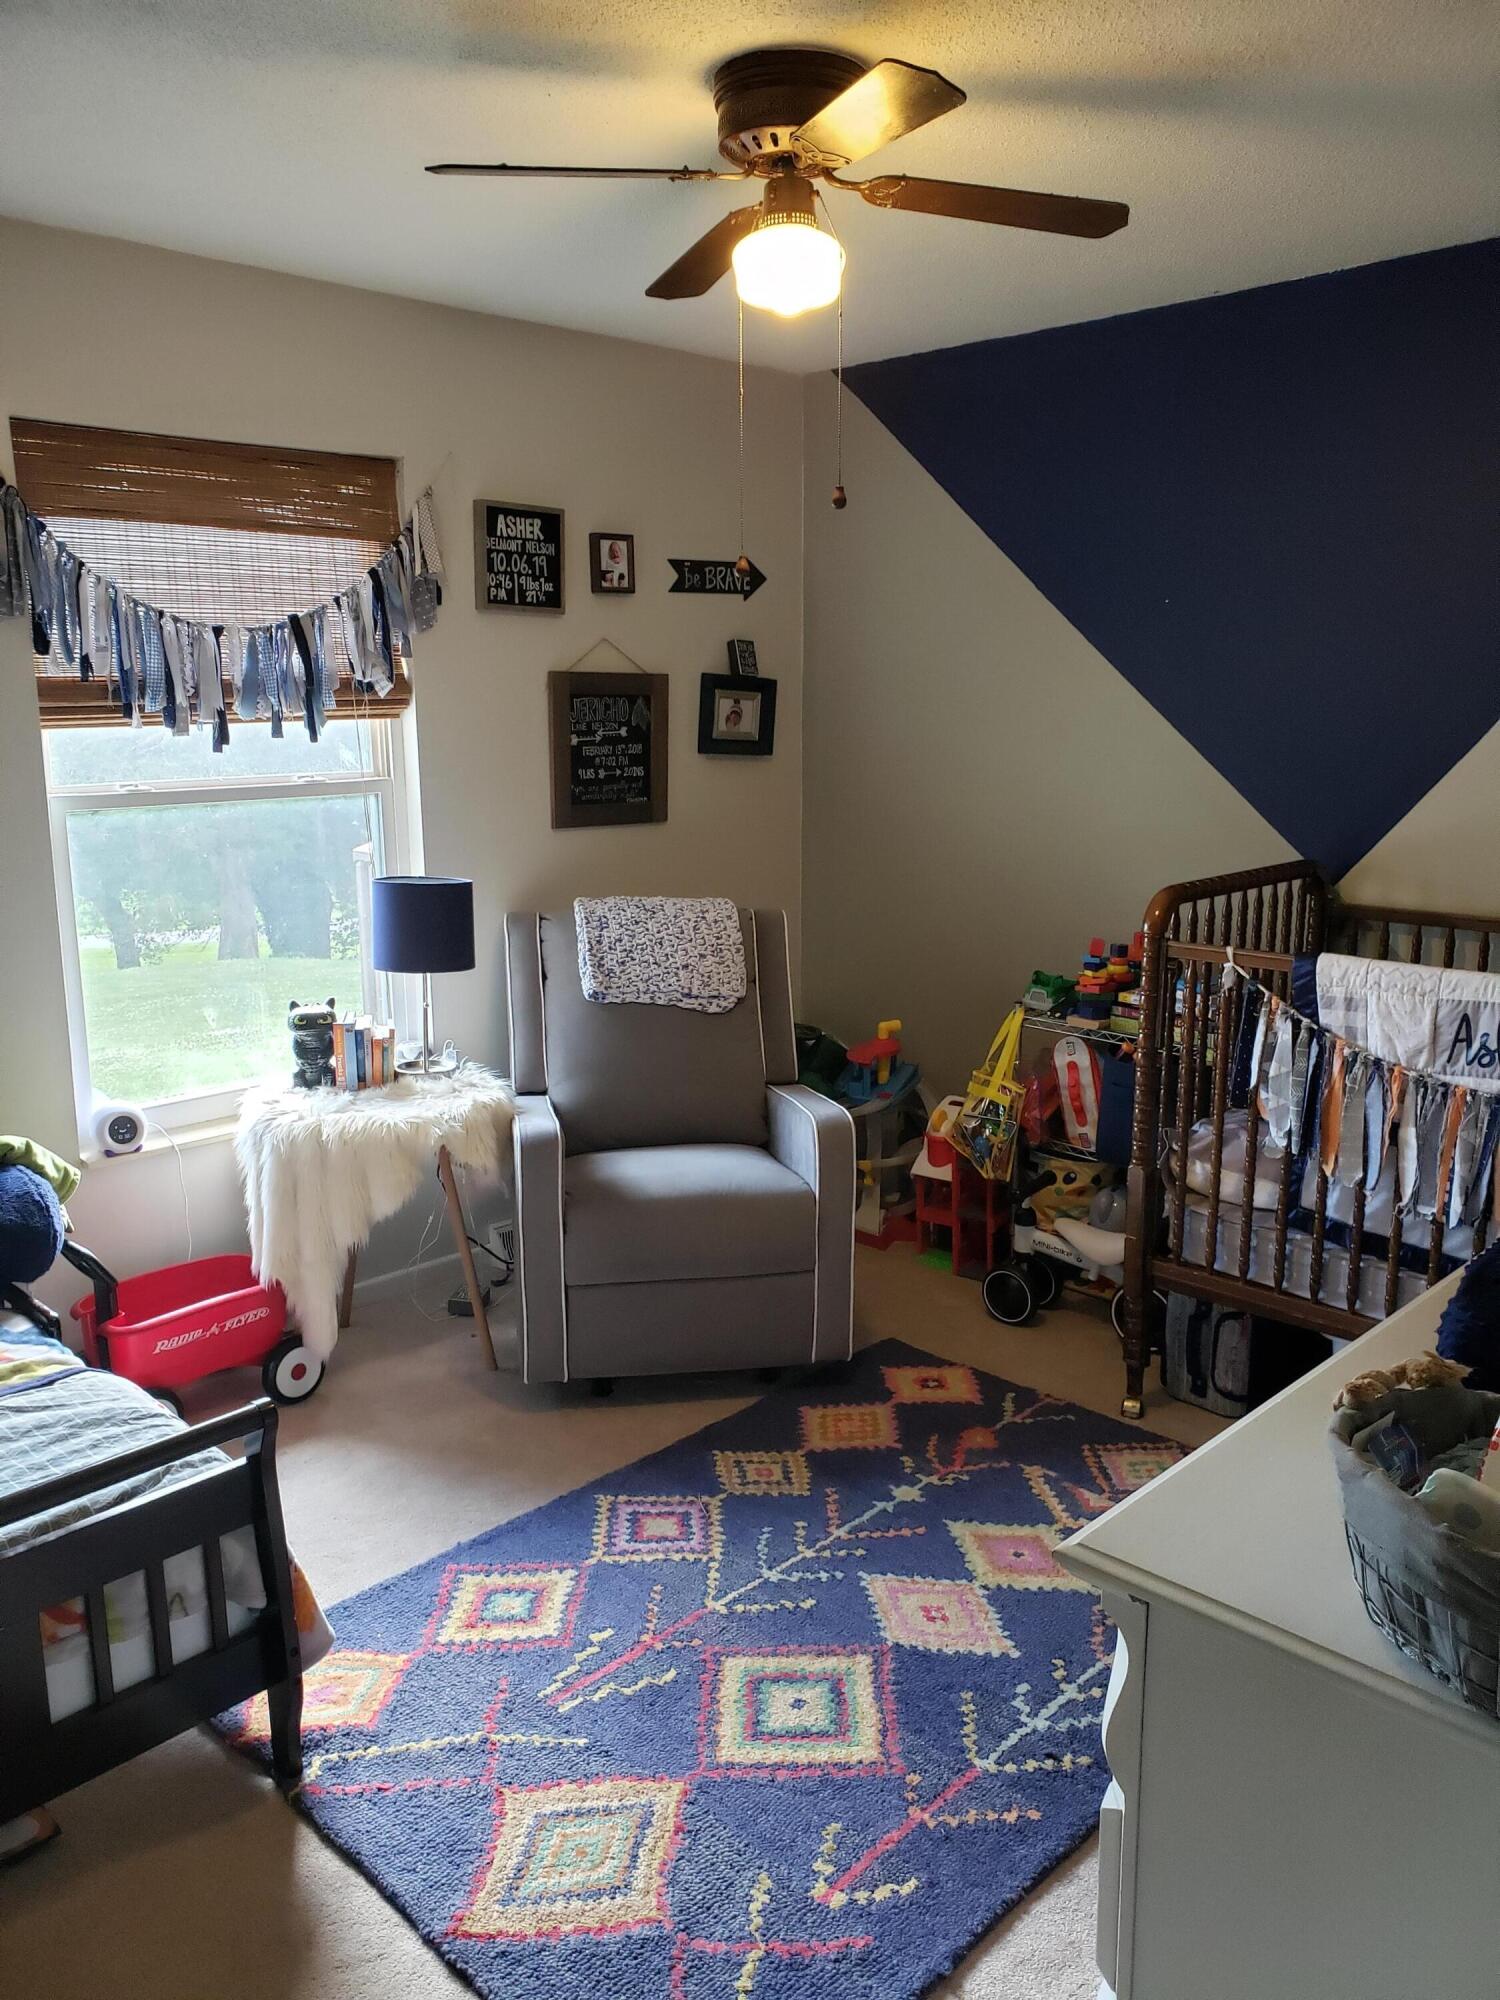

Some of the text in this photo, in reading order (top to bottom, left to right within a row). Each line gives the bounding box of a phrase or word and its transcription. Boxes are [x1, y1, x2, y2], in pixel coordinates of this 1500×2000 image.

[496, 513, 545, 540] ASHER
[525, 540, 556, 557] NELSON
[490, 551, 548, 577] 10.06.19
[684, 566, 751, 591] be BRAVE
[490, 587, 508, 601] PM
[570, 696, 629, 722] JERICHO
[582, 745, 613, 757] FEBRUARY
[1446, 1012, 1500, 1069] As
[152, 1306, 270, 1355] RADIO FLYER
